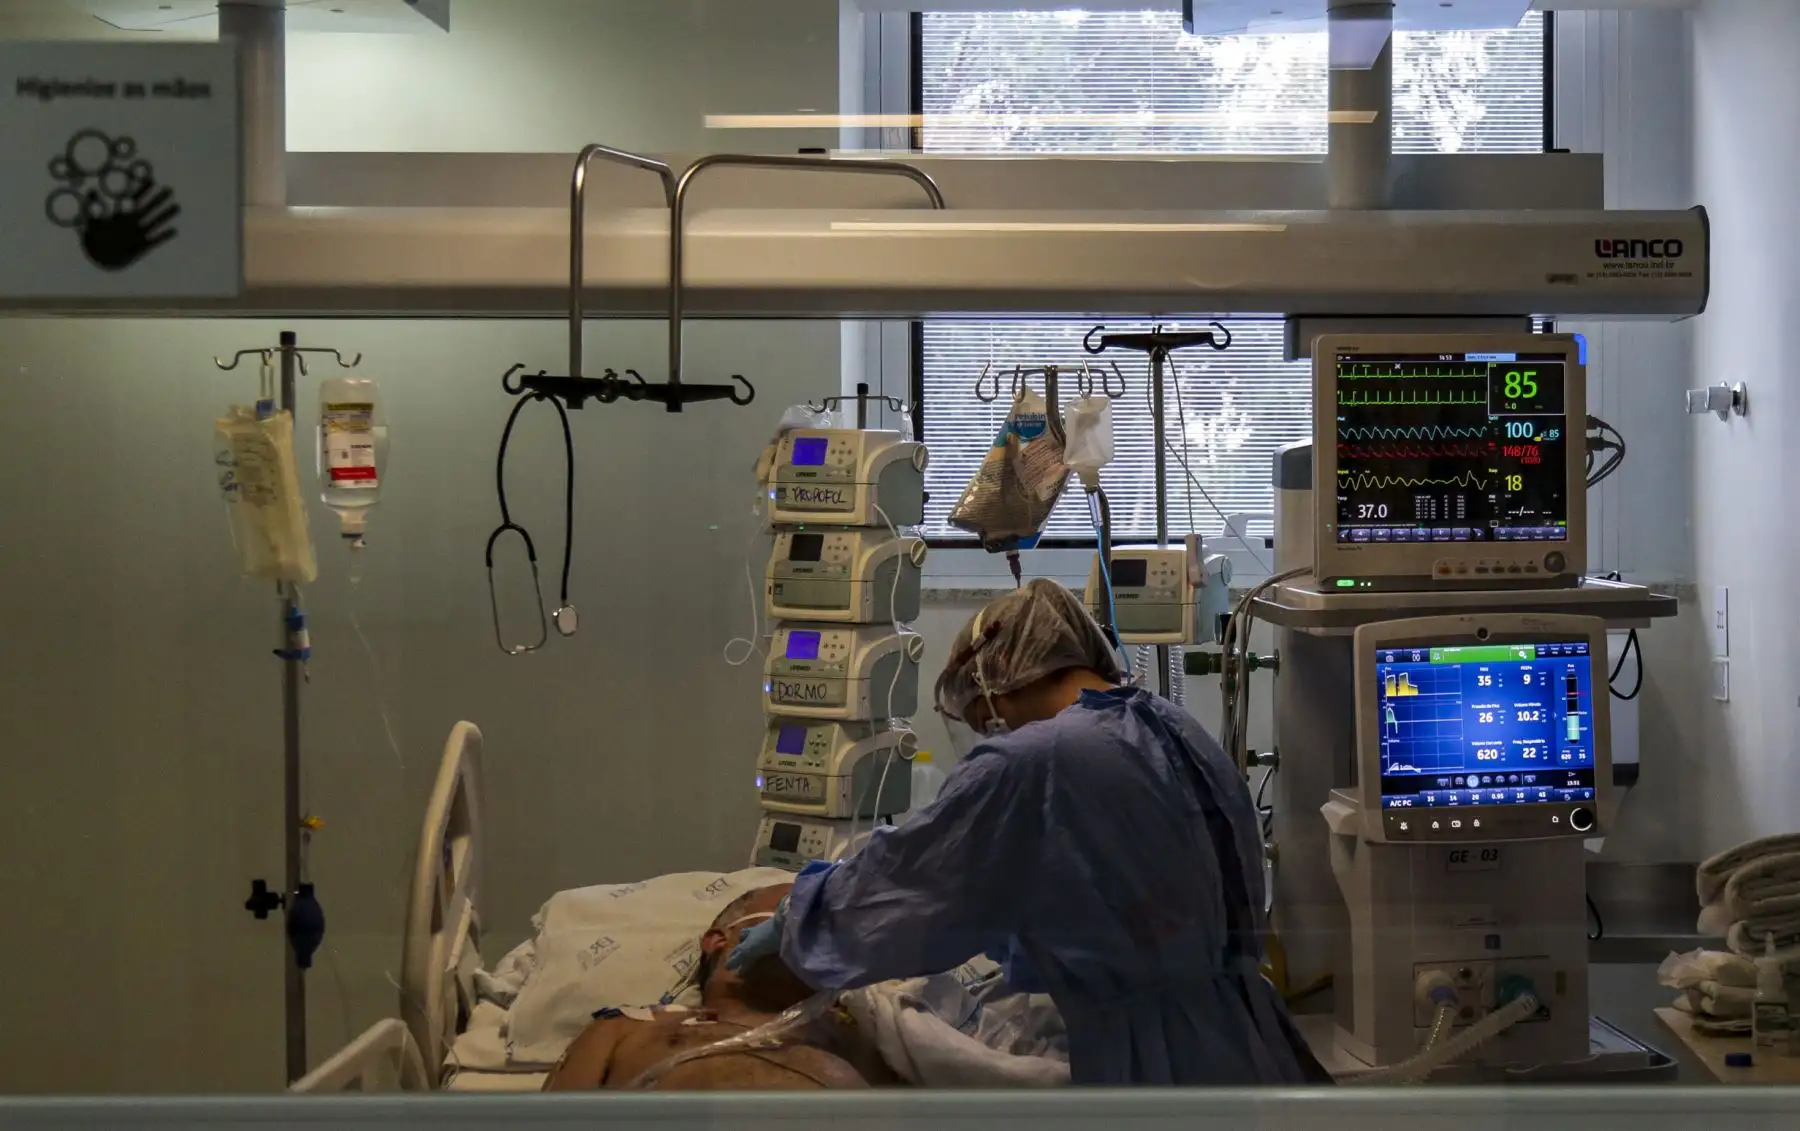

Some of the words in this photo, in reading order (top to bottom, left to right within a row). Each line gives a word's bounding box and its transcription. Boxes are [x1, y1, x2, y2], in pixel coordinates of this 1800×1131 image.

[1595, 239, 1684, 258] LANCO
[1504, 371, 1538, 399] 85
[1504, 422, 1534, 438] 100
[1549, 429, 1560, 438] 85
[1504, 475, 1523, 491] 18
[1358, 504, 1388, 519] 37.0
[1477, 675, 1492, 687] 35
[1523, 673, 1531, 685] 9
[778, 680, 827, 700] DORMO
[1479, 711, 1494, 723] 26
[1517, 710, 1539, 722] 10.2
[1477, 748, 1498, 760] 620
[1522, 747, 1536, 759] 22
[766, 775, 811, 793] FENTA
[1449, 850, 1470, 863] GE
[1481, 848, 1498, 861] 03
